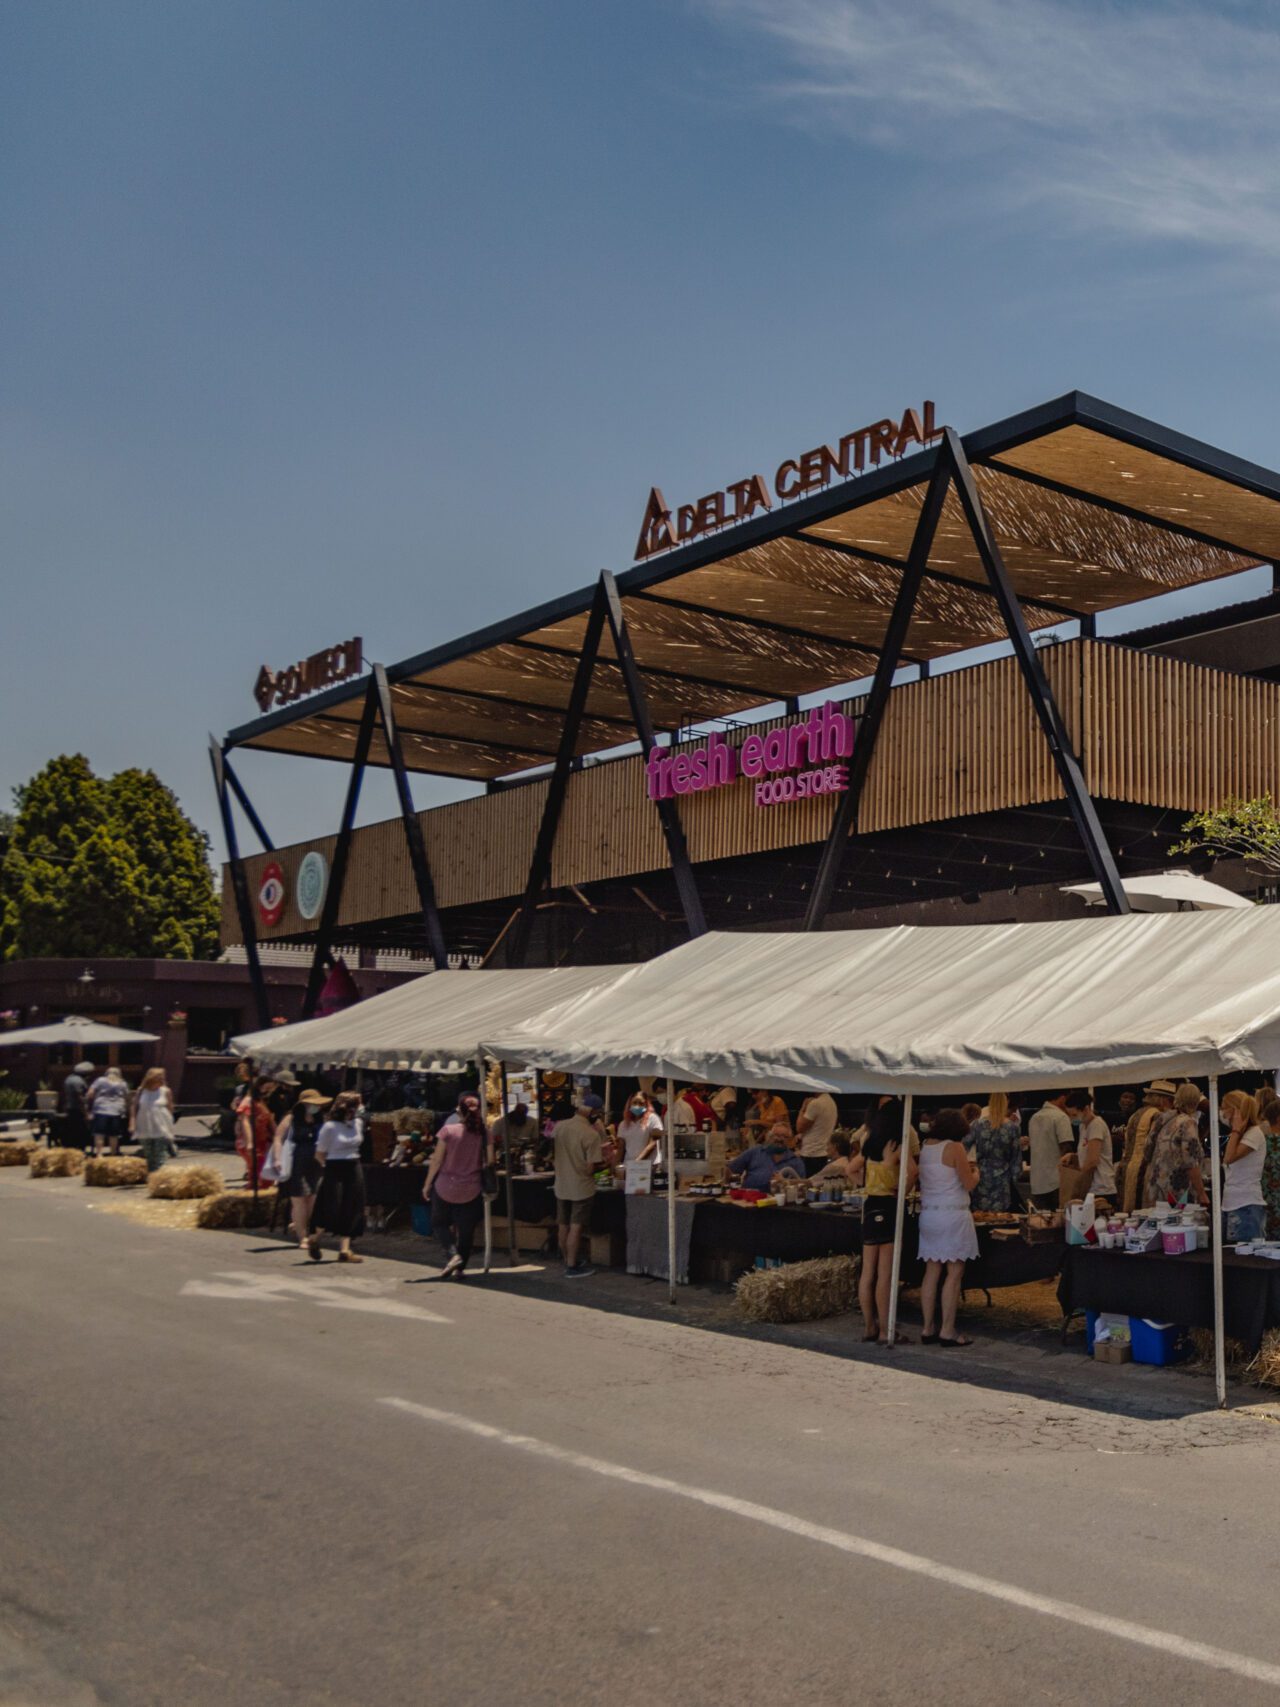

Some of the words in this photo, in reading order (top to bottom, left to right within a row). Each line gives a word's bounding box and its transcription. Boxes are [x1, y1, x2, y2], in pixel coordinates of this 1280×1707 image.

[677, 474, 772, 542] DELTA
[774, 400, 947, 499] CENTRAL
[646, 730, 736, 800] fresh
[741, 700, 853, 777] earth
[755, 776, 796, 806] FOOD
[796, 764, 849, 797] STORE
